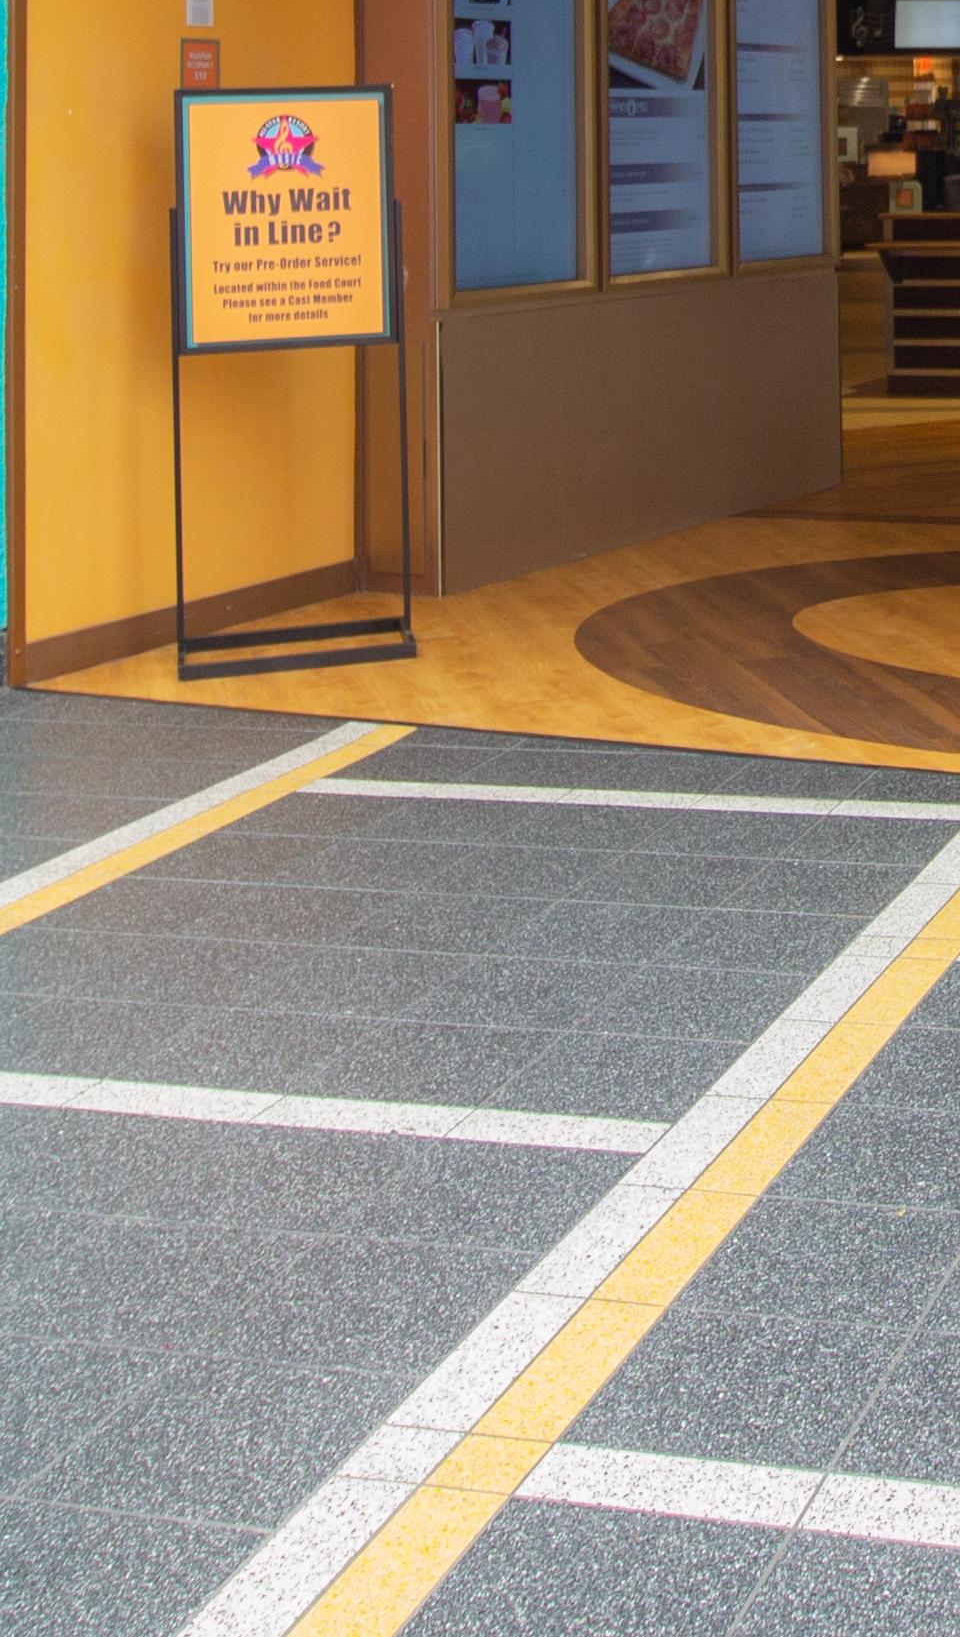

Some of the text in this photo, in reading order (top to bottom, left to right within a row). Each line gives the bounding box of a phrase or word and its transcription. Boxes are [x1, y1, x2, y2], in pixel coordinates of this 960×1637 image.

[222, 186, 352, 217] Why Wait
[234, 222, 259, 247] in
[213, 254, 362, 274] Try our Pre-Order Service!
[213, 277, 362, 295] Located within the Food Court
[222, 293, 353, 310] Please see a Cast Member
[248, 309, 328, 324] for more details
